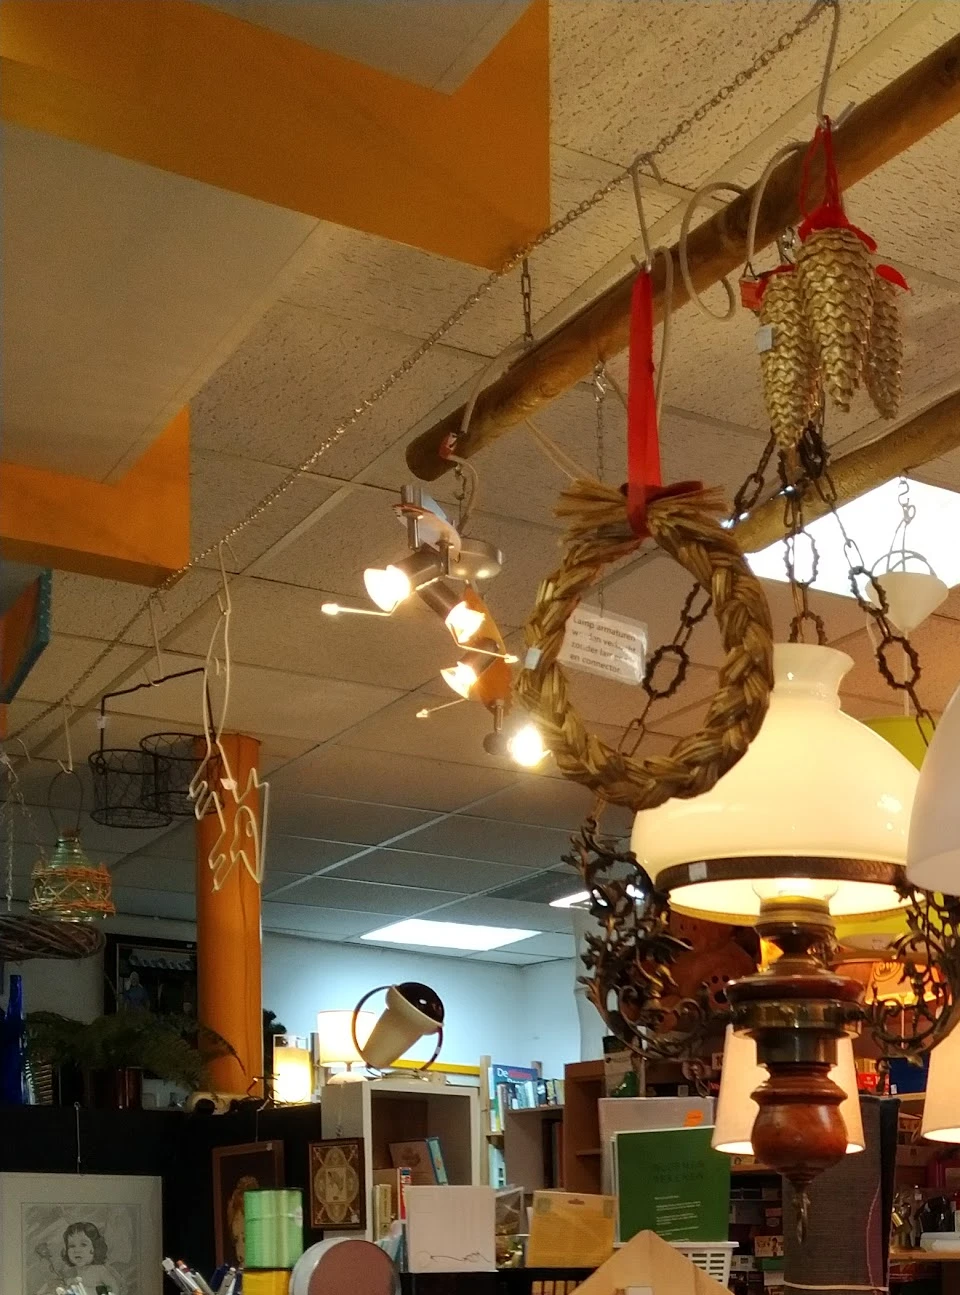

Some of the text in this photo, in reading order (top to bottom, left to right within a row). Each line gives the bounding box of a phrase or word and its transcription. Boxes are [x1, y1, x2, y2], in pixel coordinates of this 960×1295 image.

[574, 615, 636, 641] Lamp armaturen
[570, 653, 620, 673] en connector
